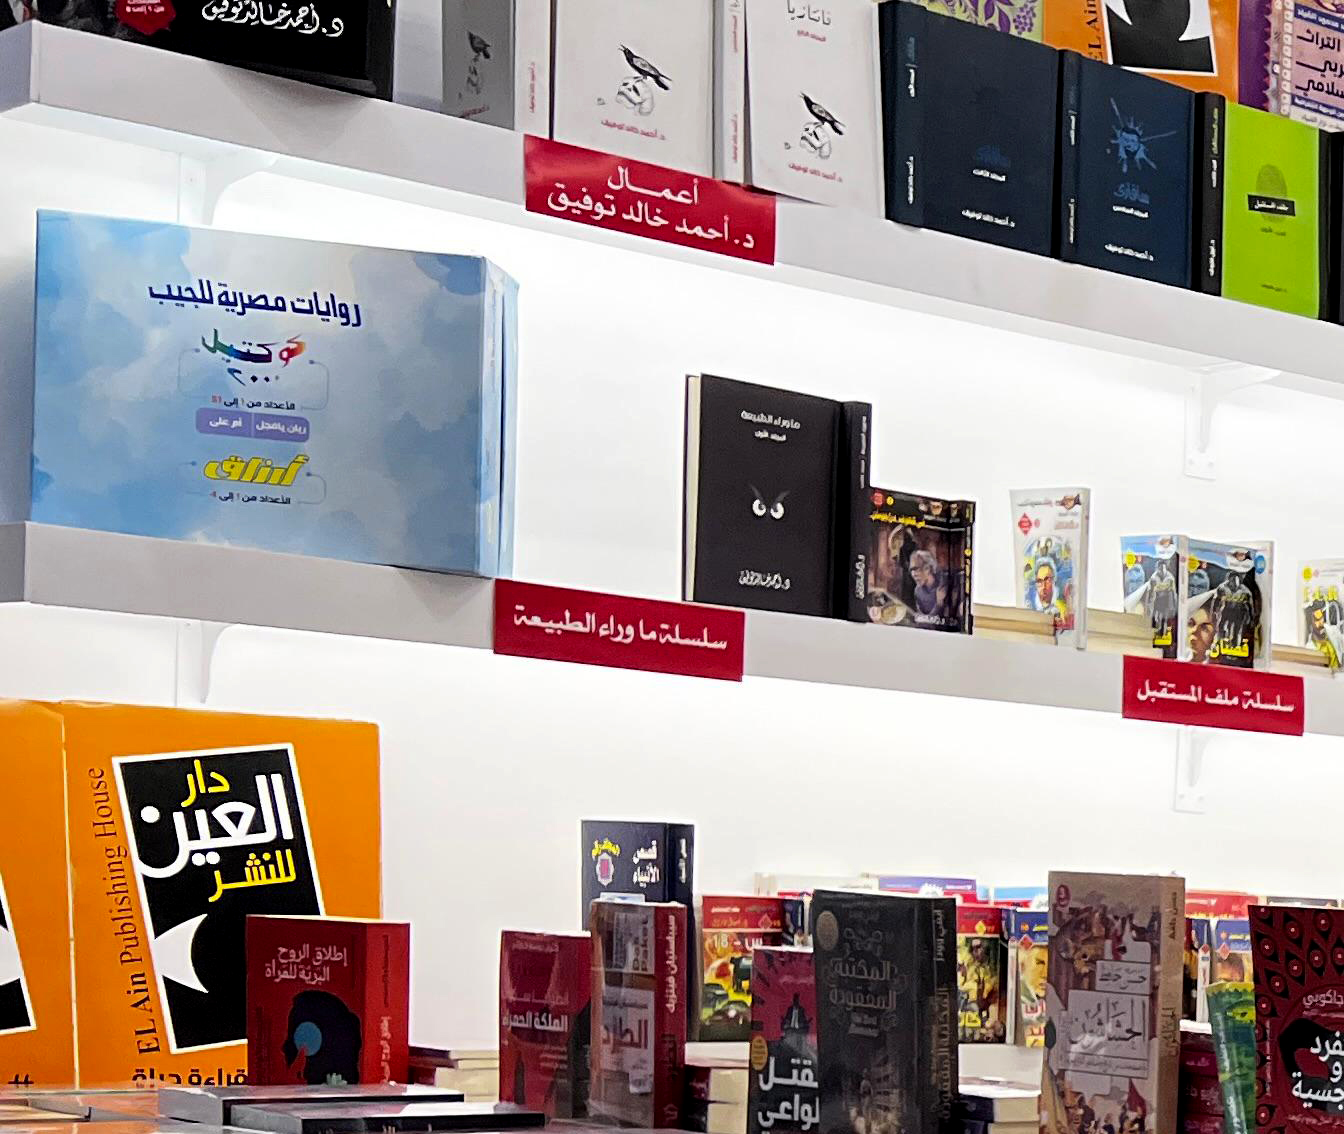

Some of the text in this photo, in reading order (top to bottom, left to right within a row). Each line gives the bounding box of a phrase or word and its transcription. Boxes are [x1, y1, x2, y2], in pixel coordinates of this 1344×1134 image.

[1297, 24, 1342, 53] التراث
[548, 183, 615, 220] توفيق
[622, 202, 669, 227] خالد
[675, 216, 729, 241] أحمد
[149, 279, 362, 327] روايات مصرية للجيب
[513, 604, 727, 650] سلسلة ما وراء الطبيعة
[1136, 676, 1295, 713] سلسلة ملف المستقبل
[182, 760, 230, 807] دار
[138, 773, 294, 879] العين
[208, 848, 296, 902] للنشر
[88, 767, 161, 1055] EL Ain Publishing House
[277, 944, 348, 966] إطلاق الروح
[1302, 991, 1344, 1011] جاكوبي
[1331, 1062, 1342, 1081] و
